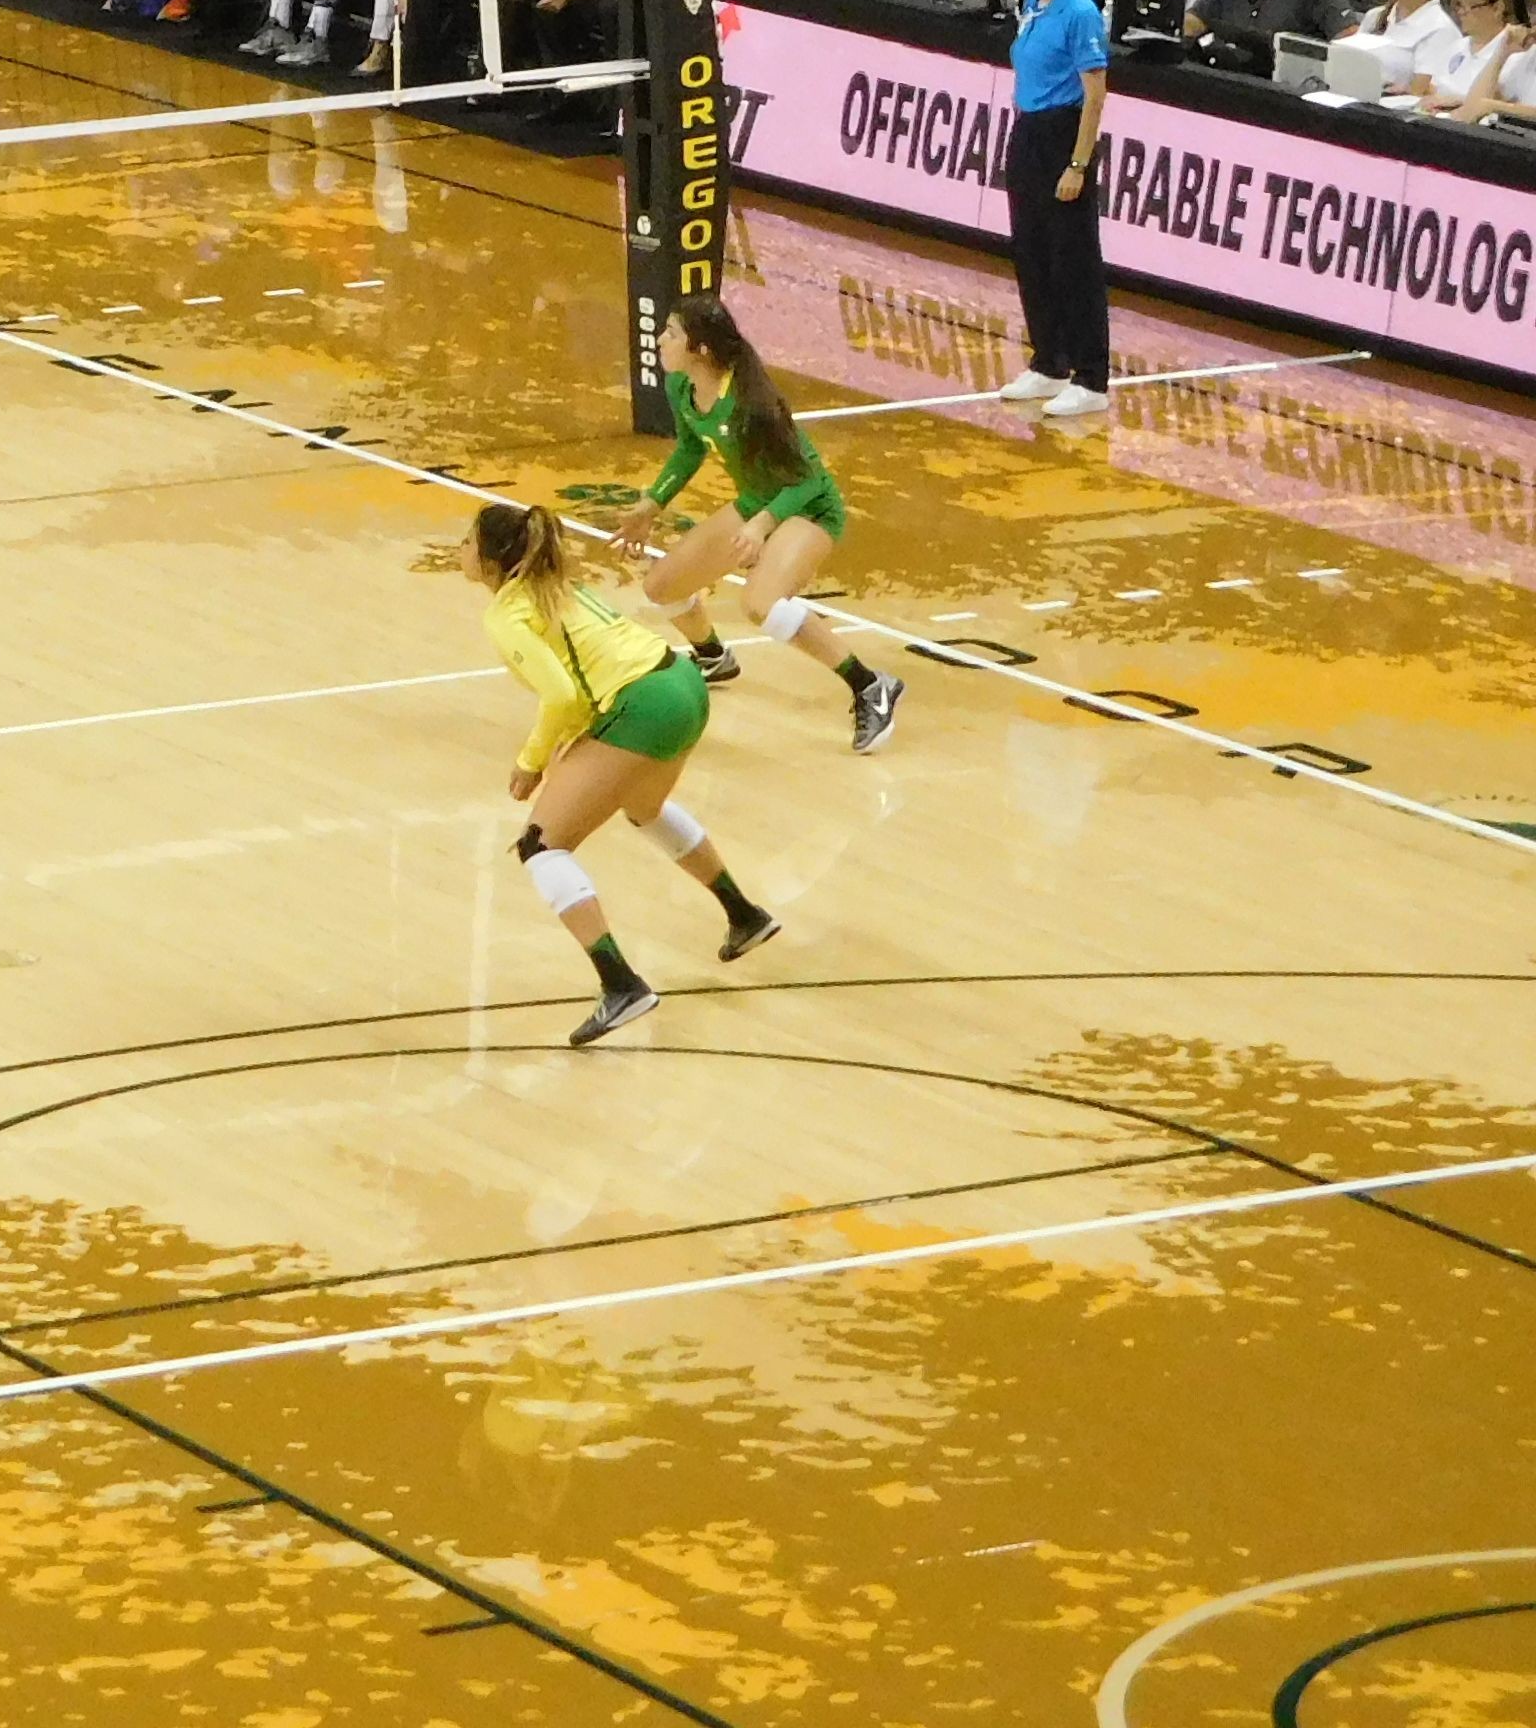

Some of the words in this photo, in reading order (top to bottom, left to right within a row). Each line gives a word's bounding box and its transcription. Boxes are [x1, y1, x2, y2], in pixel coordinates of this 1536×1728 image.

[679, 54, 719, 296] OREGON
[1260, 170, 1534, 324] TECHNOLOG
[638, 296, 658, 389] Senoh
